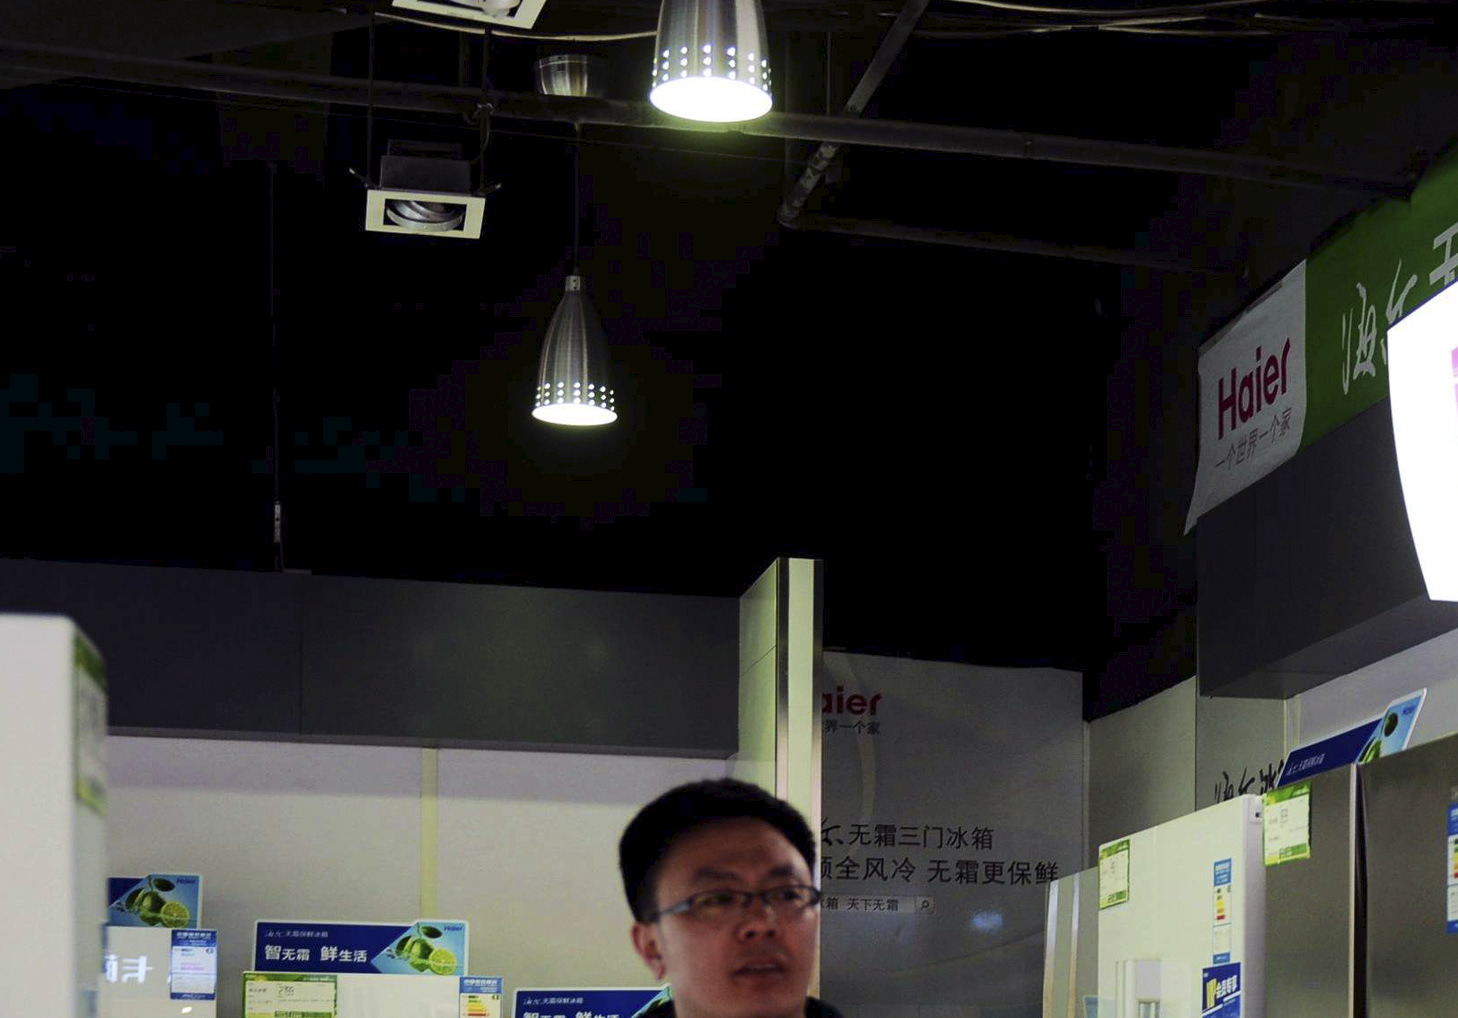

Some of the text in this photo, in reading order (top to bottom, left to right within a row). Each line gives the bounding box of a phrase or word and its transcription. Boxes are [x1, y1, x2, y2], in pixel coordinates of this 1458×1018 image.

[1217, 337, 1291, 441] Haier
[1214, 407, 1293, 472] 一个世界一个家
[927, 859, 1059, 885] 无霜更保鲜
[821, 897, 899, 912] 箱 天下无霜
[264, 944, 368, 962] 智无霜 鲜生活
